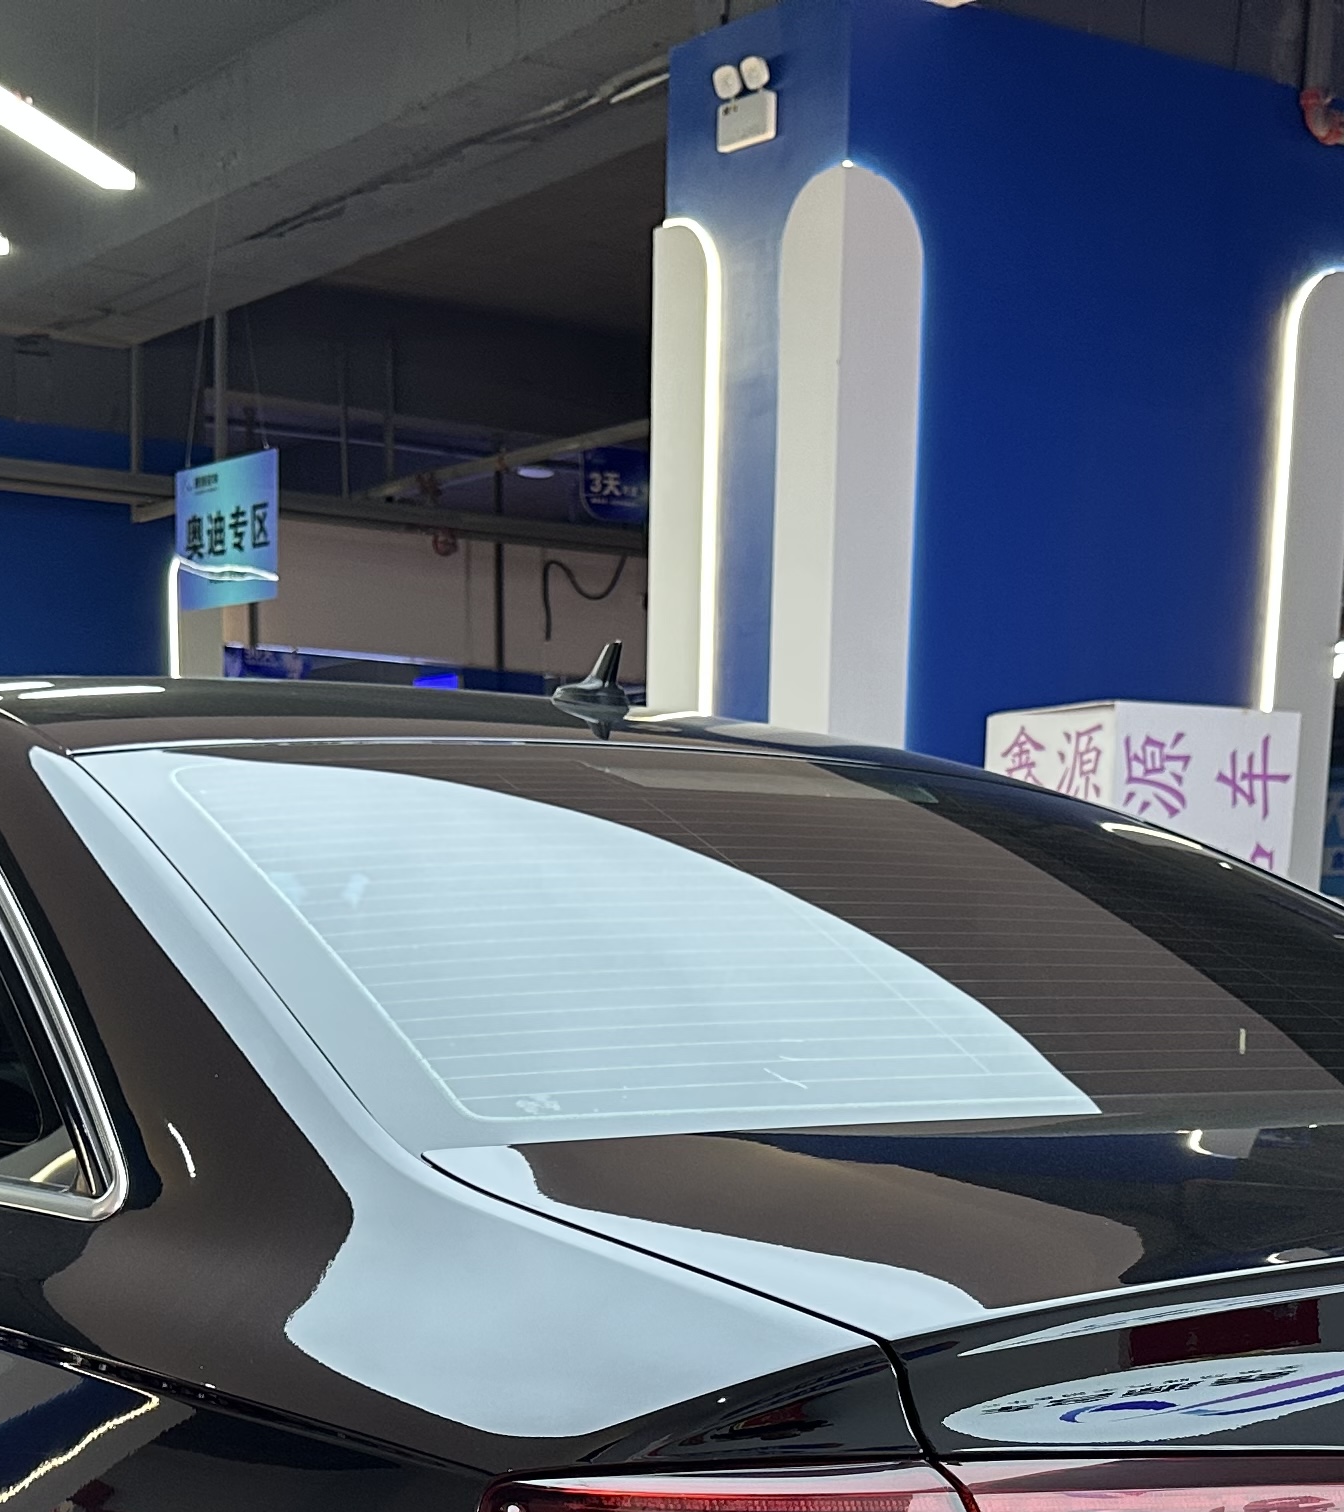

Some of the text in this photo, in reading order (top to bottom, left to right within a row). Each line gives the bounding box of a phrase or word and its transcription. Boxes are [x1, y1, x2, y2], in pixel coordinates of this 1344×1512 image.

[589, 471, 622, 496] 3天
[185, 501, 271, 560] 奥迪专区
